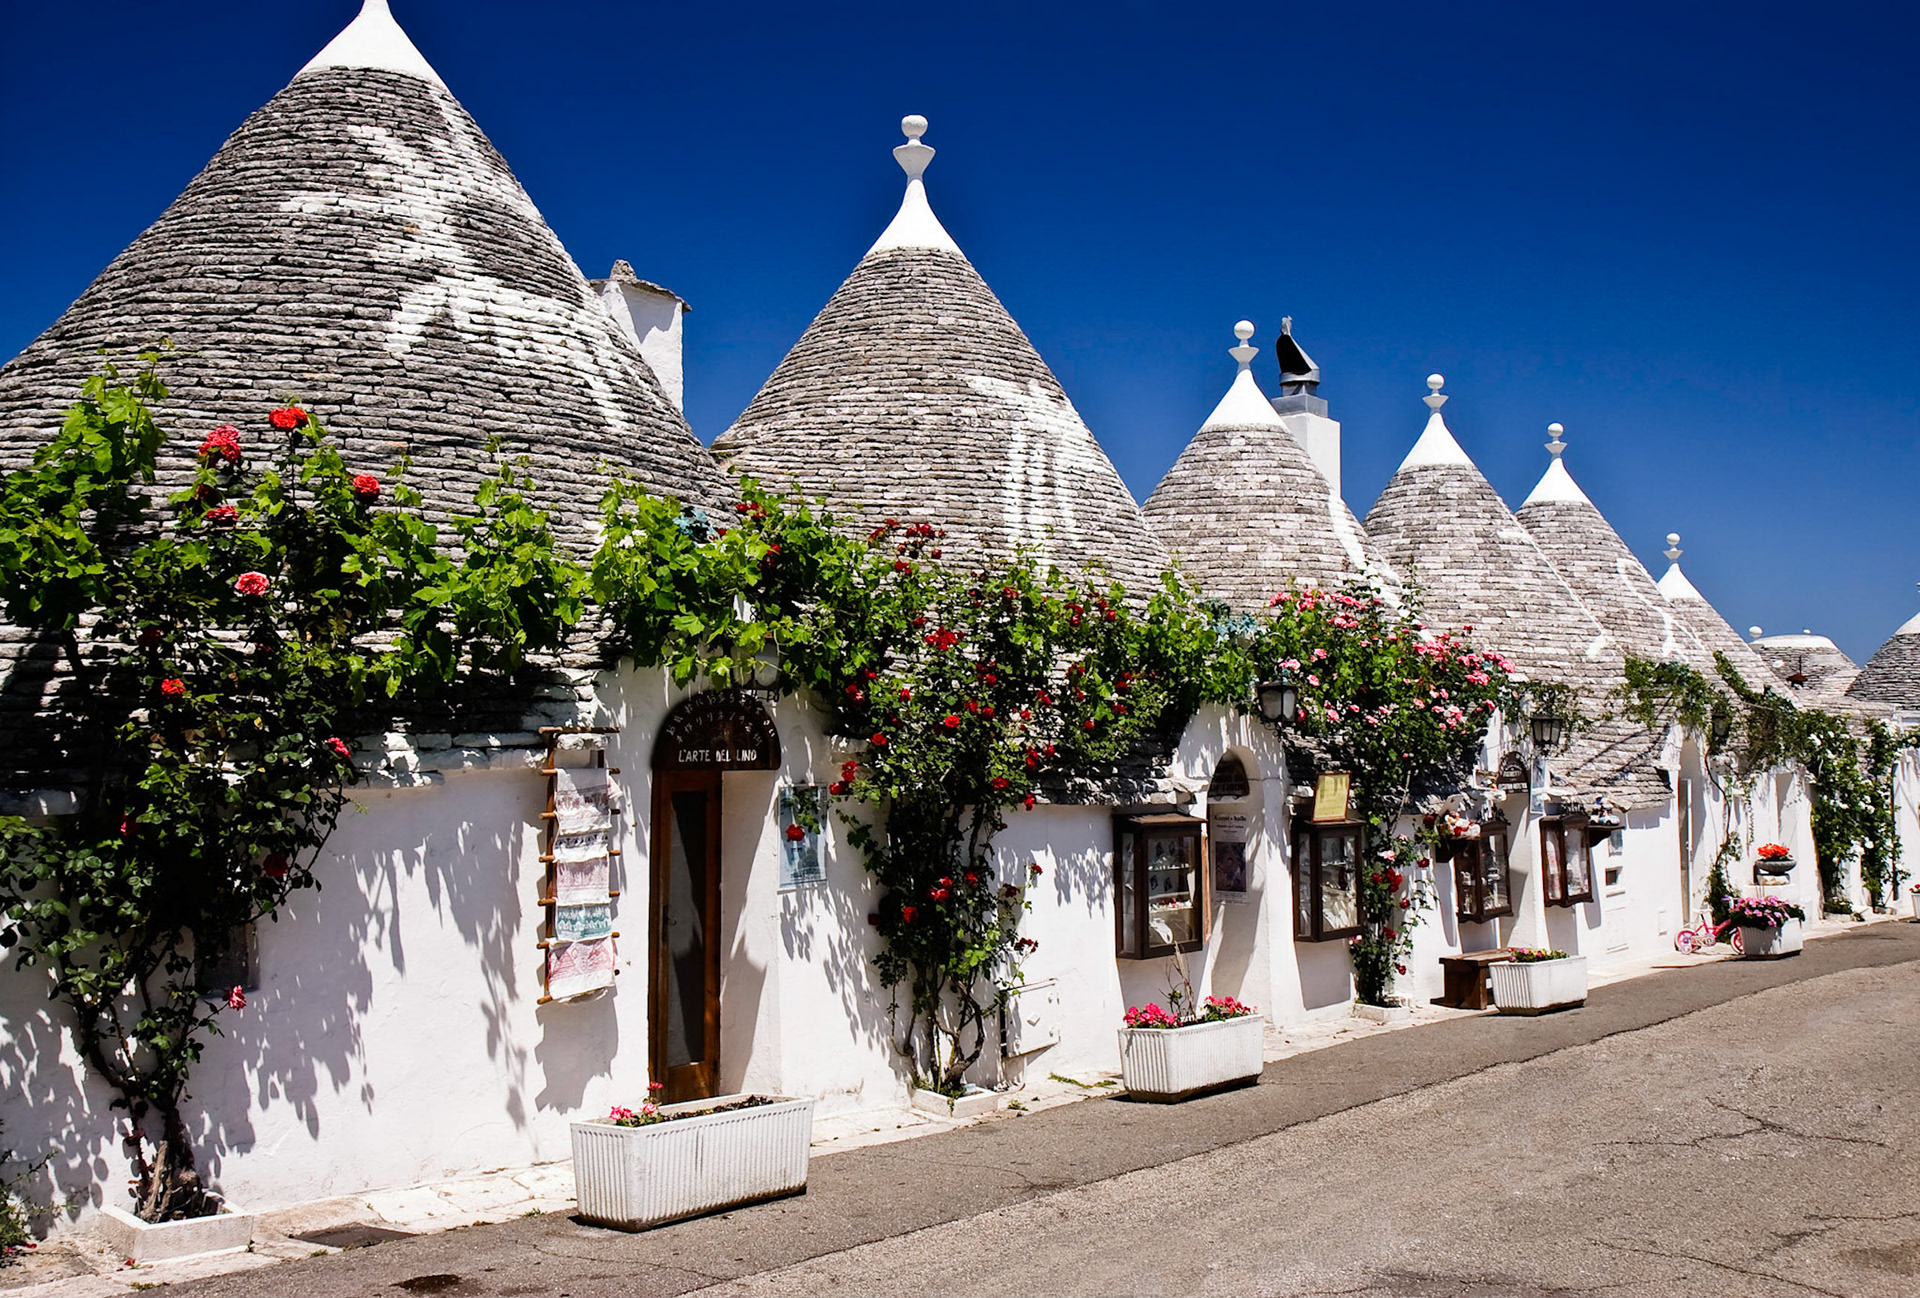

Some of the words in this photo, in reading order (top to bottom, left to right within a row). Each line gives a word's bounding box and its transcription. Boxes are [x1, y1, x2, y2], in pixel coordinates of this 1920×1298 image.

[678, 749, 711, 762] L'ARTE
[716, 749, 731, 762] DEL
[736, 749, 757, 761] LINO
